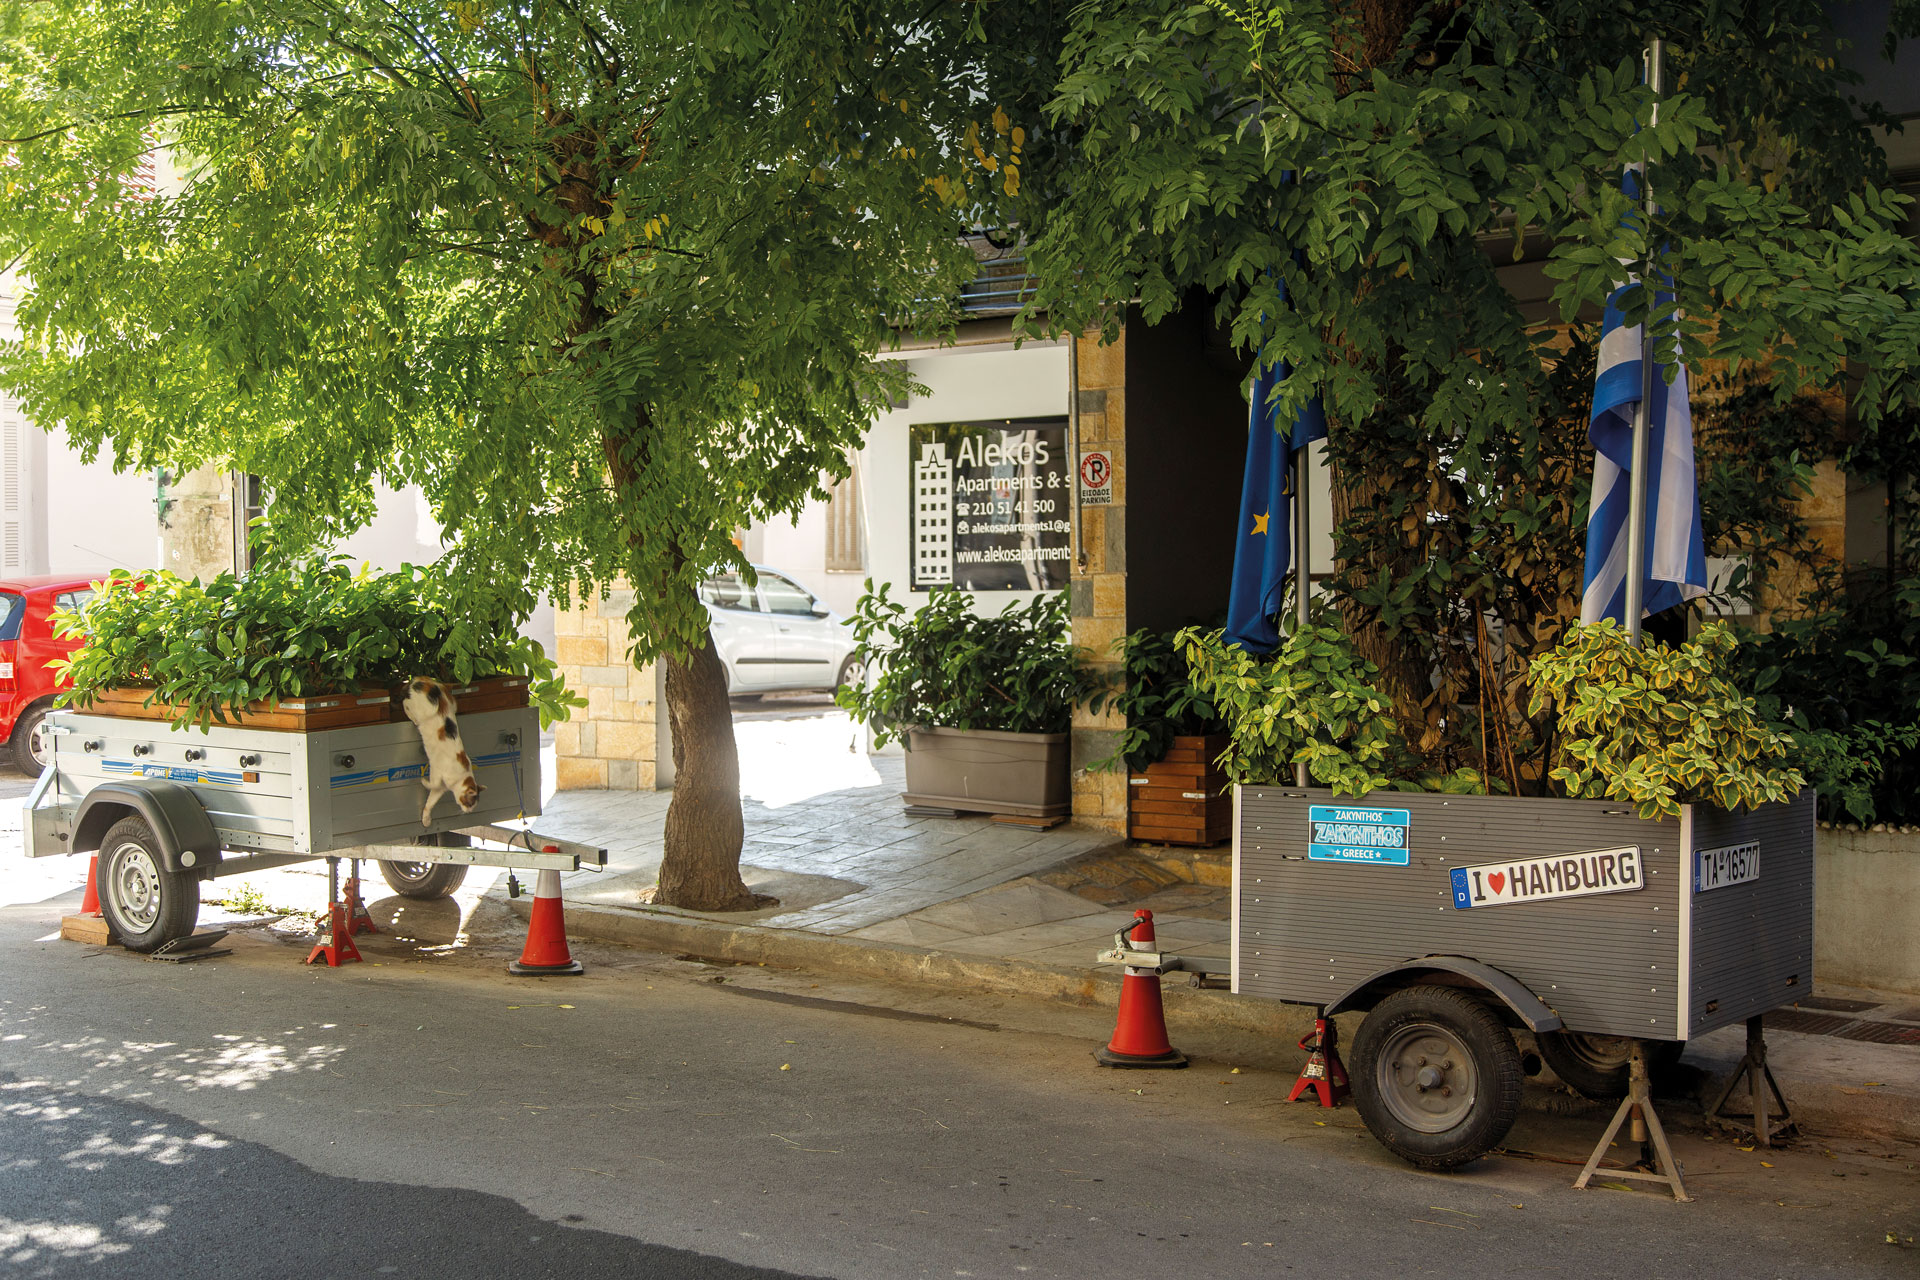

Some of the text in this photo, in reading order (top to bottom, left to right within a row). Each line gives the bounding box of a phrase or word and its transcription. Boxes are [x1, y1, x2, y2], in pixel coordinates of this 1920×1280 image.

[956, 435, 1050, 468] Alekos
[956, 474, 1043, 496] Apartments
[1047, 471, 1060, 489] &
[1080, 496, 1111, 505] PARKING
[1082, 489, 1110, 497] ΕΙΣΟΔΟΣ
[972, 499, 1055, 516] 210 51 41 500
[971, 519, 1071, 535] alekosapartments1@g
[1335, 810, 1383, 822] ZAKYNTHOS
[1314, 823, 1404, 848] ZAKYNTHOS
[1342, 848, 1374, 859] GREECE
[1472, 852, 1636, 901] I HAMBURG
[1458, 892, 1466, 902] D
